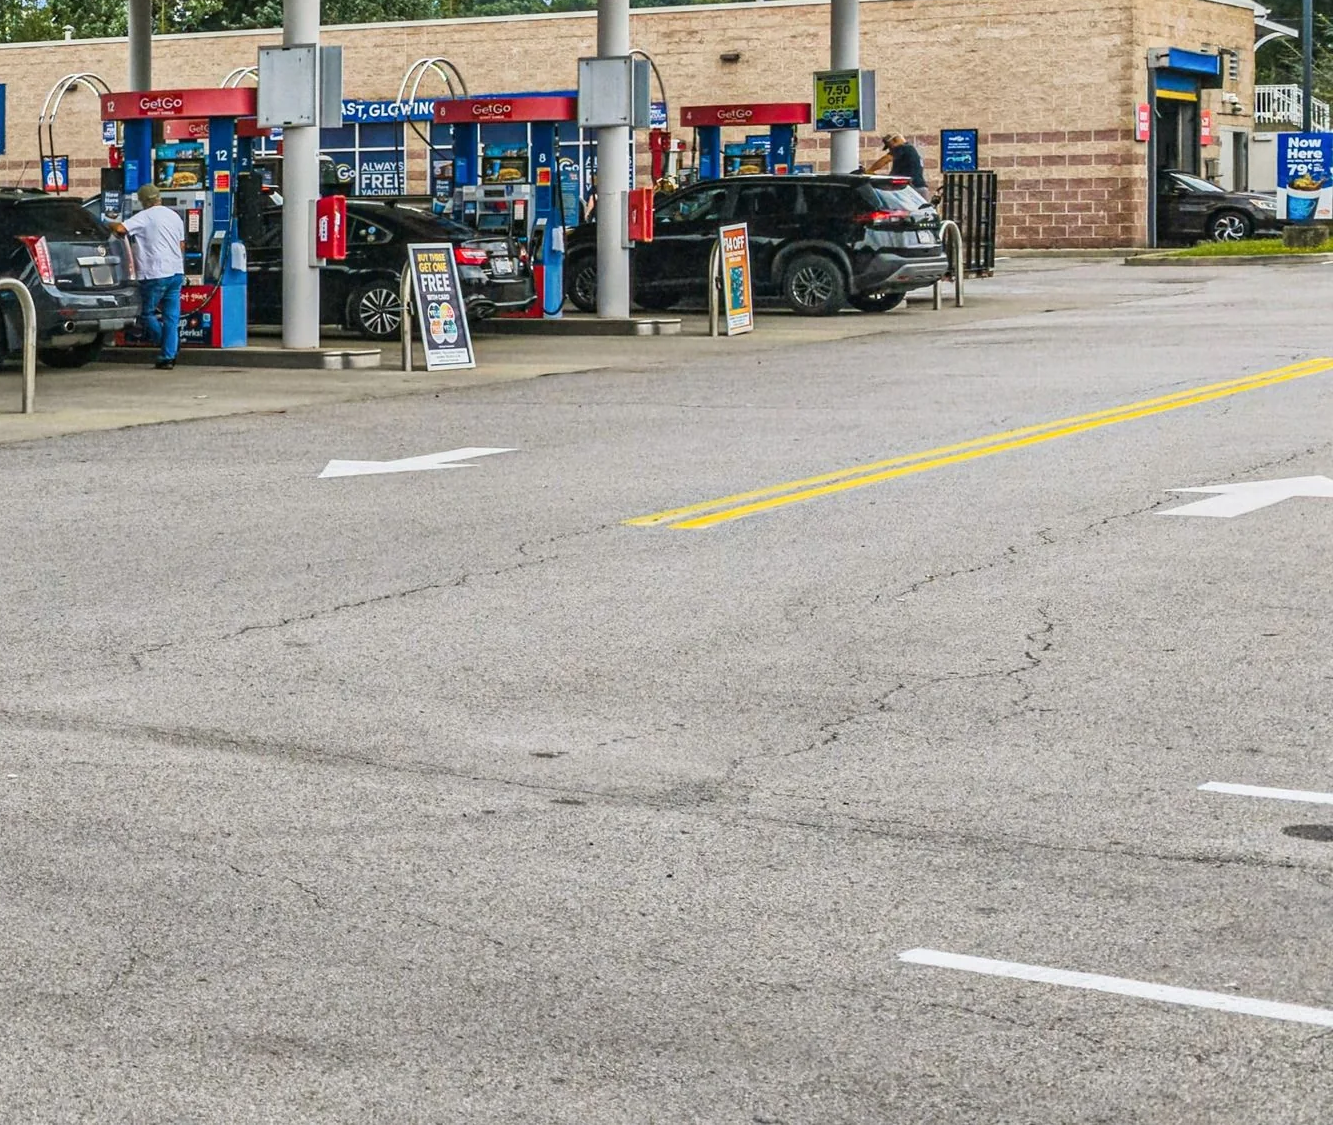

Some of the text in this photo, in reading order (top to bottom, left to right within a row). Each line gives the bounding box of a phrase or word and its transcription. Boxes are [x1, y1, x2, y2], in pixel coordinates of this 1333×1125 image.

[139, 97, 183, 111] GetGo
[827, 95, 848, 105] OFF
[106, 101, 115, 112] 12
[340, 102, 367, 120] AST,
[472, 103, 512, 116] GetGo
[717, 109, 753, 119] GetGo
[188, 124, 209, 134] GetG
[1288, 136, 1322, 148] Now
[215, 149, 228, 162] 12
[777, 146, 784, 156] 4
[1286, 148, 1323, 159] Here
[241, 157, 248, 166] 2
[538, 152, 547, 163] 8
[361, 161, 404, 172] ALWAYS
[733, 235, 745, 250] OFF
[417, 253, 446, 262] BUY THREE
[418, 262, 448, 273] GET ONE
[420, 273, 452, 293] FREE
[179, 329, 203, 338] perks!
